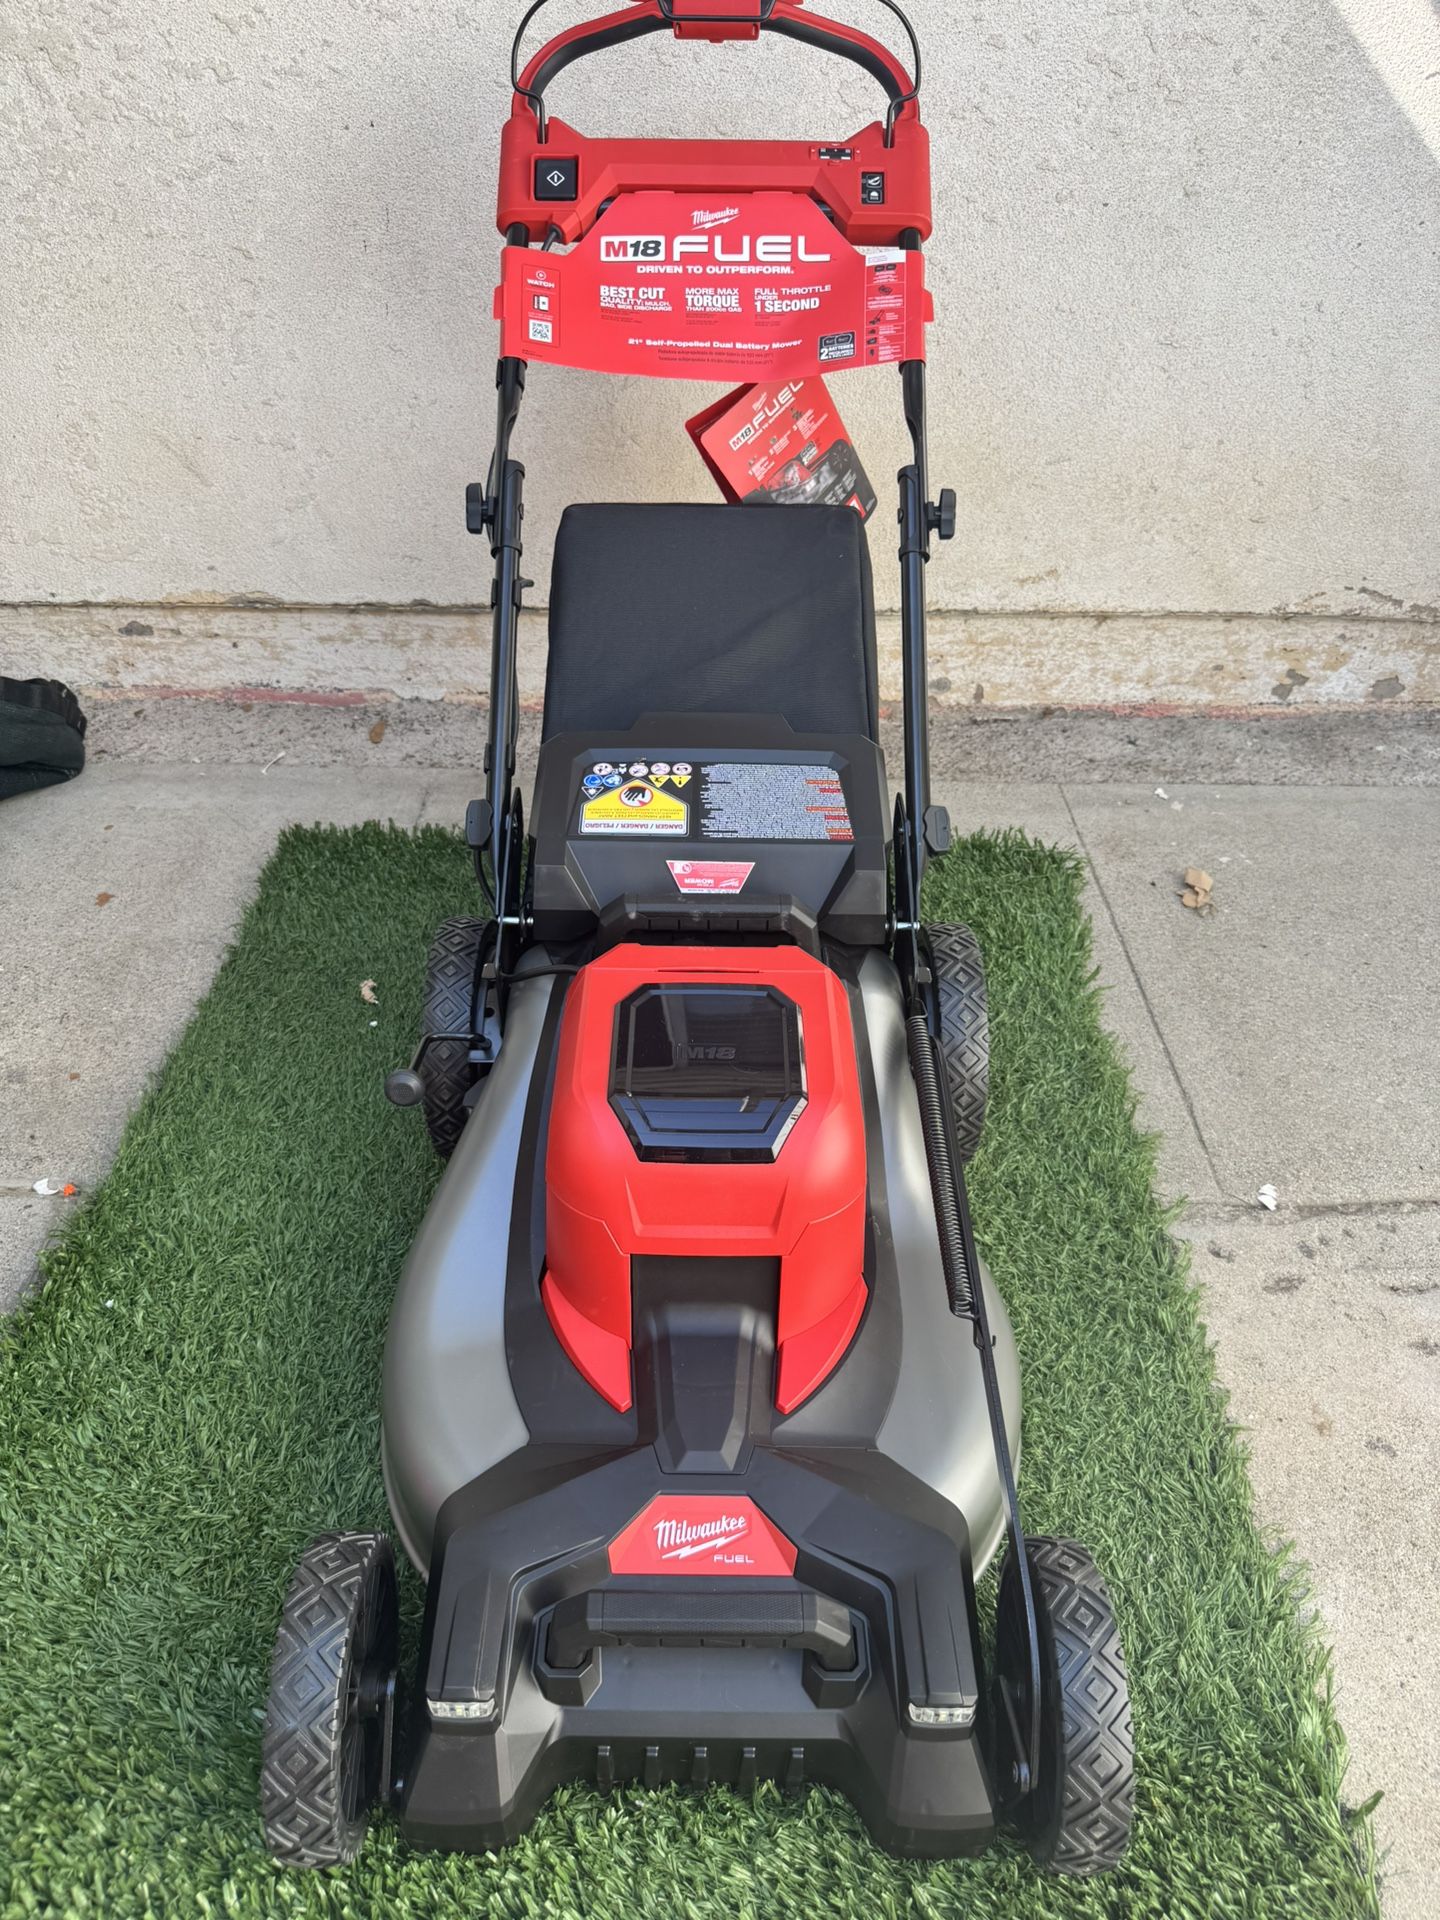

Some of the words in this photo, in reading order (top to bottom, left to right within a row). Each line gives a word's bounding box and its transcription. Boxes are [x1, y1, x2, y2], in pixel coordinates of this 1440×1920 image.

[691, 207, 739, 225] Milwaukee
[604, 240, 662, 258] M18
[673, 235, 831, 262] FUEL
[637, 265, 683, 274] DRIVEN
[686, 265, 703, 274] TO
[706, 265, 795, 275] OUTPERFORM.
[527, 279, 555, 289] WATCH
[754, 288, 778, 296] FULL
[780, 284, 832, 295] THROTTLE
[600, 285, 635, 299] BEST
[639, 287, 666, 300] CUT
[686, 288, 714, 296] MORE
[686, 295, 739, 308] TORQUE
[754, 301, 762, 312] 1
[764, 297, 820, 313] SECOND
[645, 339, 711, 349] Self-Propelled
[712, 341, 734, 349] Dual
[736, 341, 770, 351] Battery
[772, 339, 803, 349] Mower
[820, 347, 829, 360] 2
[752, 380, 804, 429] FUEL
[686, 1046, 736, 1060] M18
[653, 1515, 747, 1550] Milwaukee
[714, 1554, 754, 1563] FUEL
